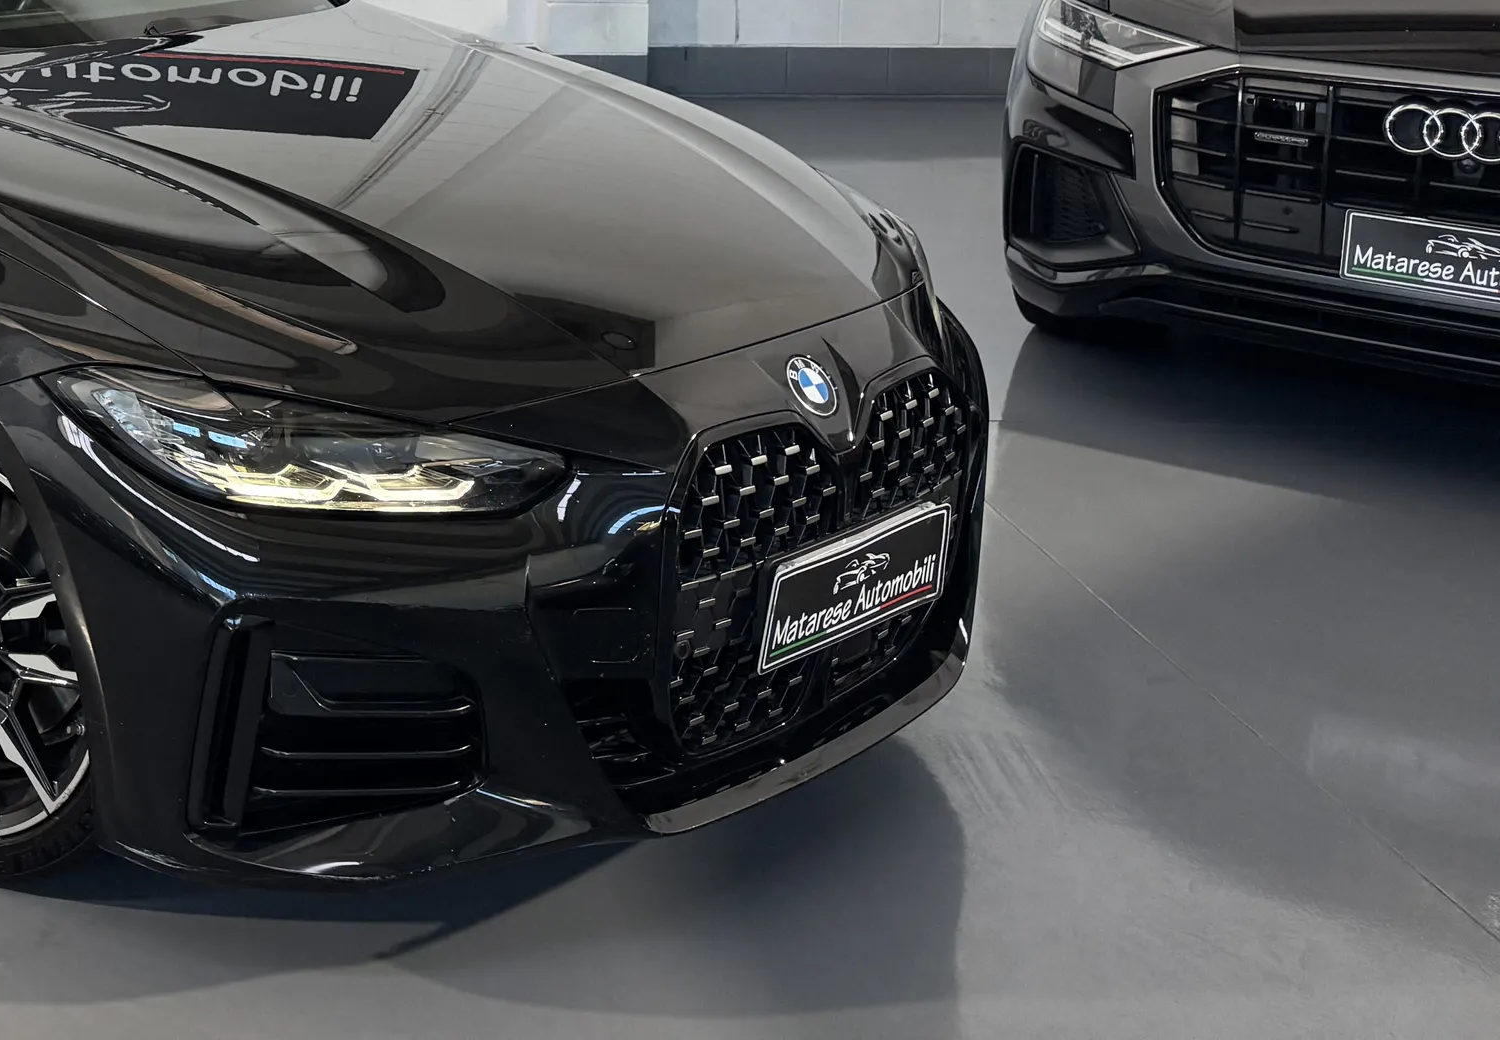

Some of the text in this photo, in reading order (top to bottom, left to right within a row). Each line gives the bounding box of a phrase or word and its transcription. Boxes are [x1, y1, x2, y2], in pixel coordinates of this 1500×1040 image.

[1353, 244, 1500, 288] Matarese Aut
[771, 554, 937, 650] Matarese Automobili
